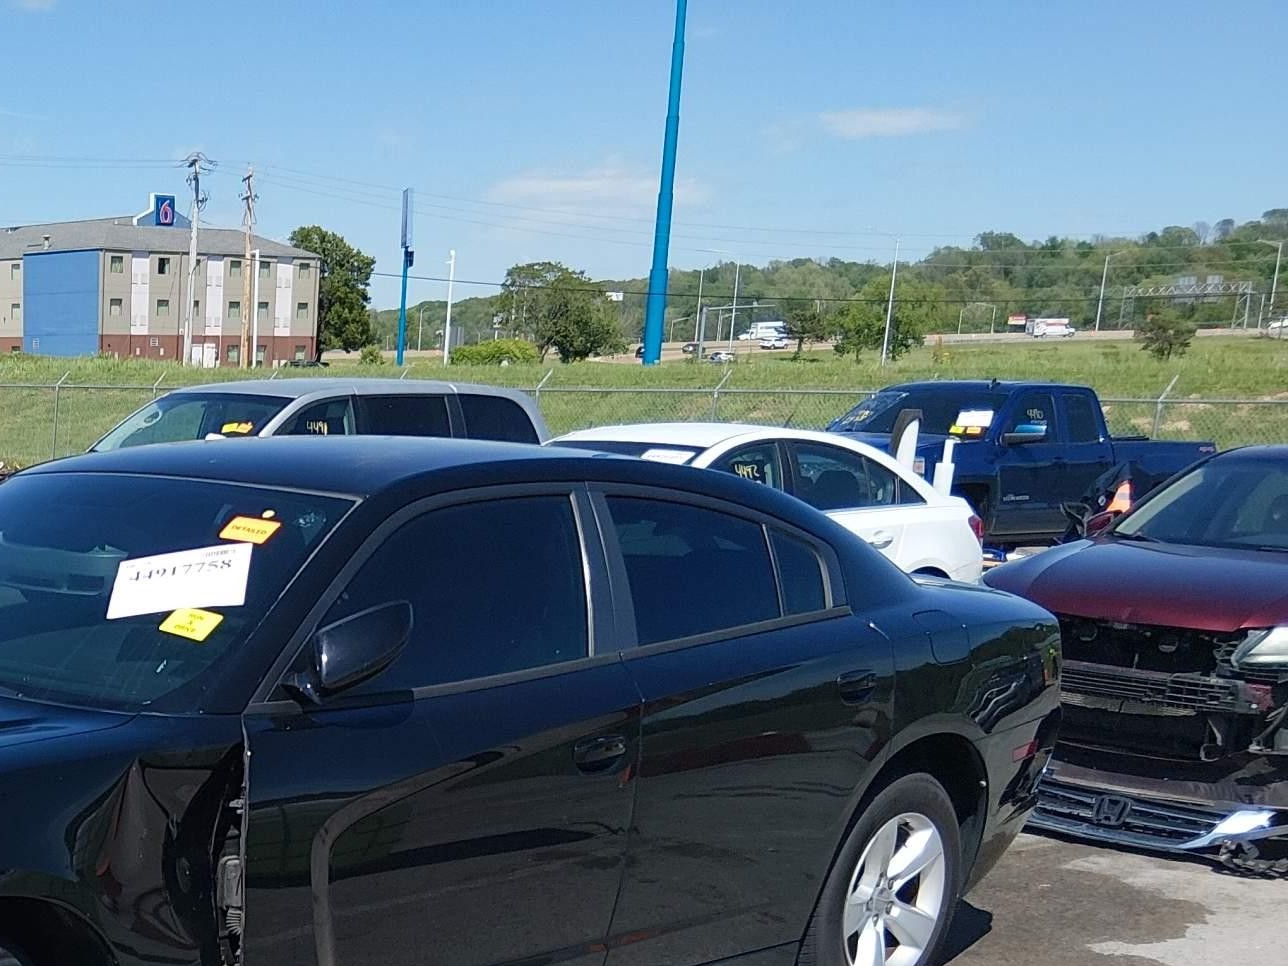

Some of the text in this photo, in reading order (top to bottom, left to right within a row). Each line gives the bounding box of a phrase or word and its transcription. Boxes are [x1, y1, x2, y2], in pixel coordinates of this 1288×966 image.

[159, 199, 173, 224] 6
[231, 524, 268, 535] DETAILED
[129, 559, 232, 582] 44917758
